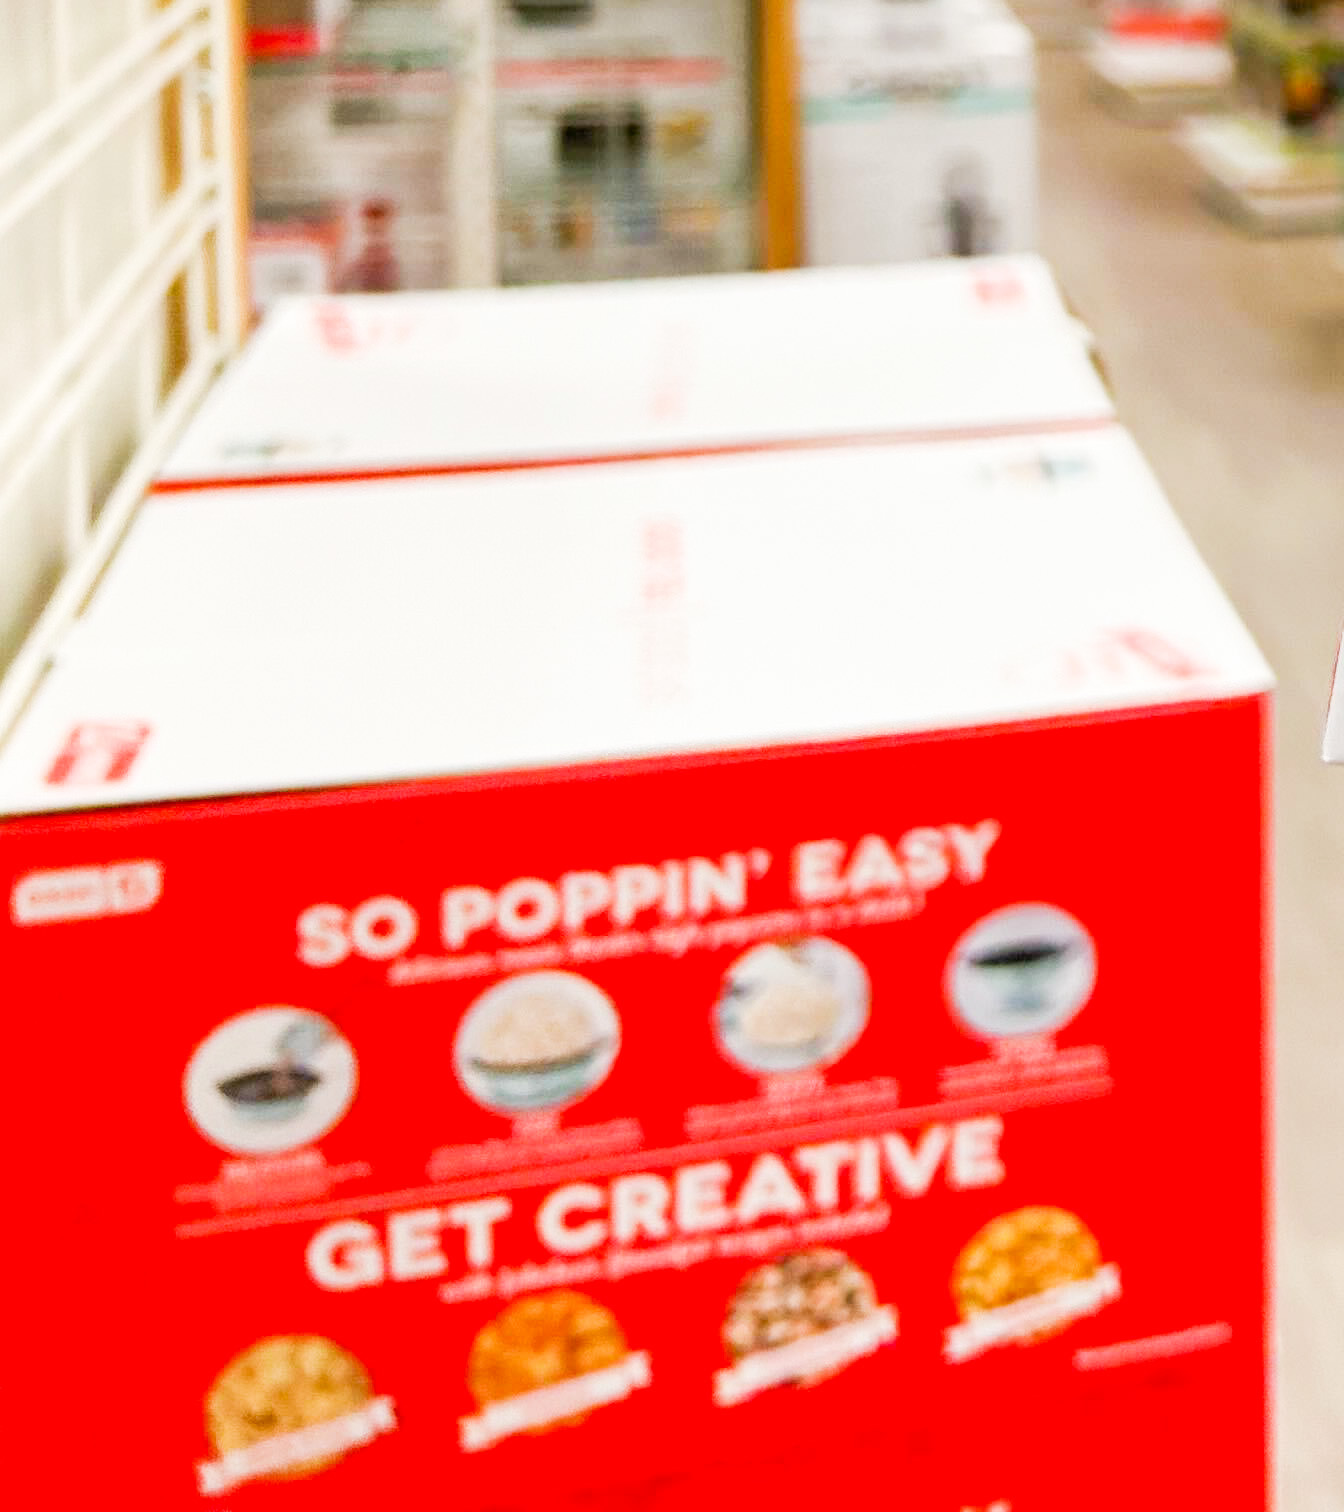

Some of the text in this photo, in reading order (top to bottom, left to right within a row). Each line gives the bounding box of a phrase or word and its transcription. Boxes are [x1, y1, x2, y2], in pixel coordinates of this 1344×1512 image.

[297, 893, 419, 969] SO
[790, 818, 1002, 901] EASY
[305, 1196, 513, 1291] GET
[536, 1115, 1006, 1256] CREATIVE
